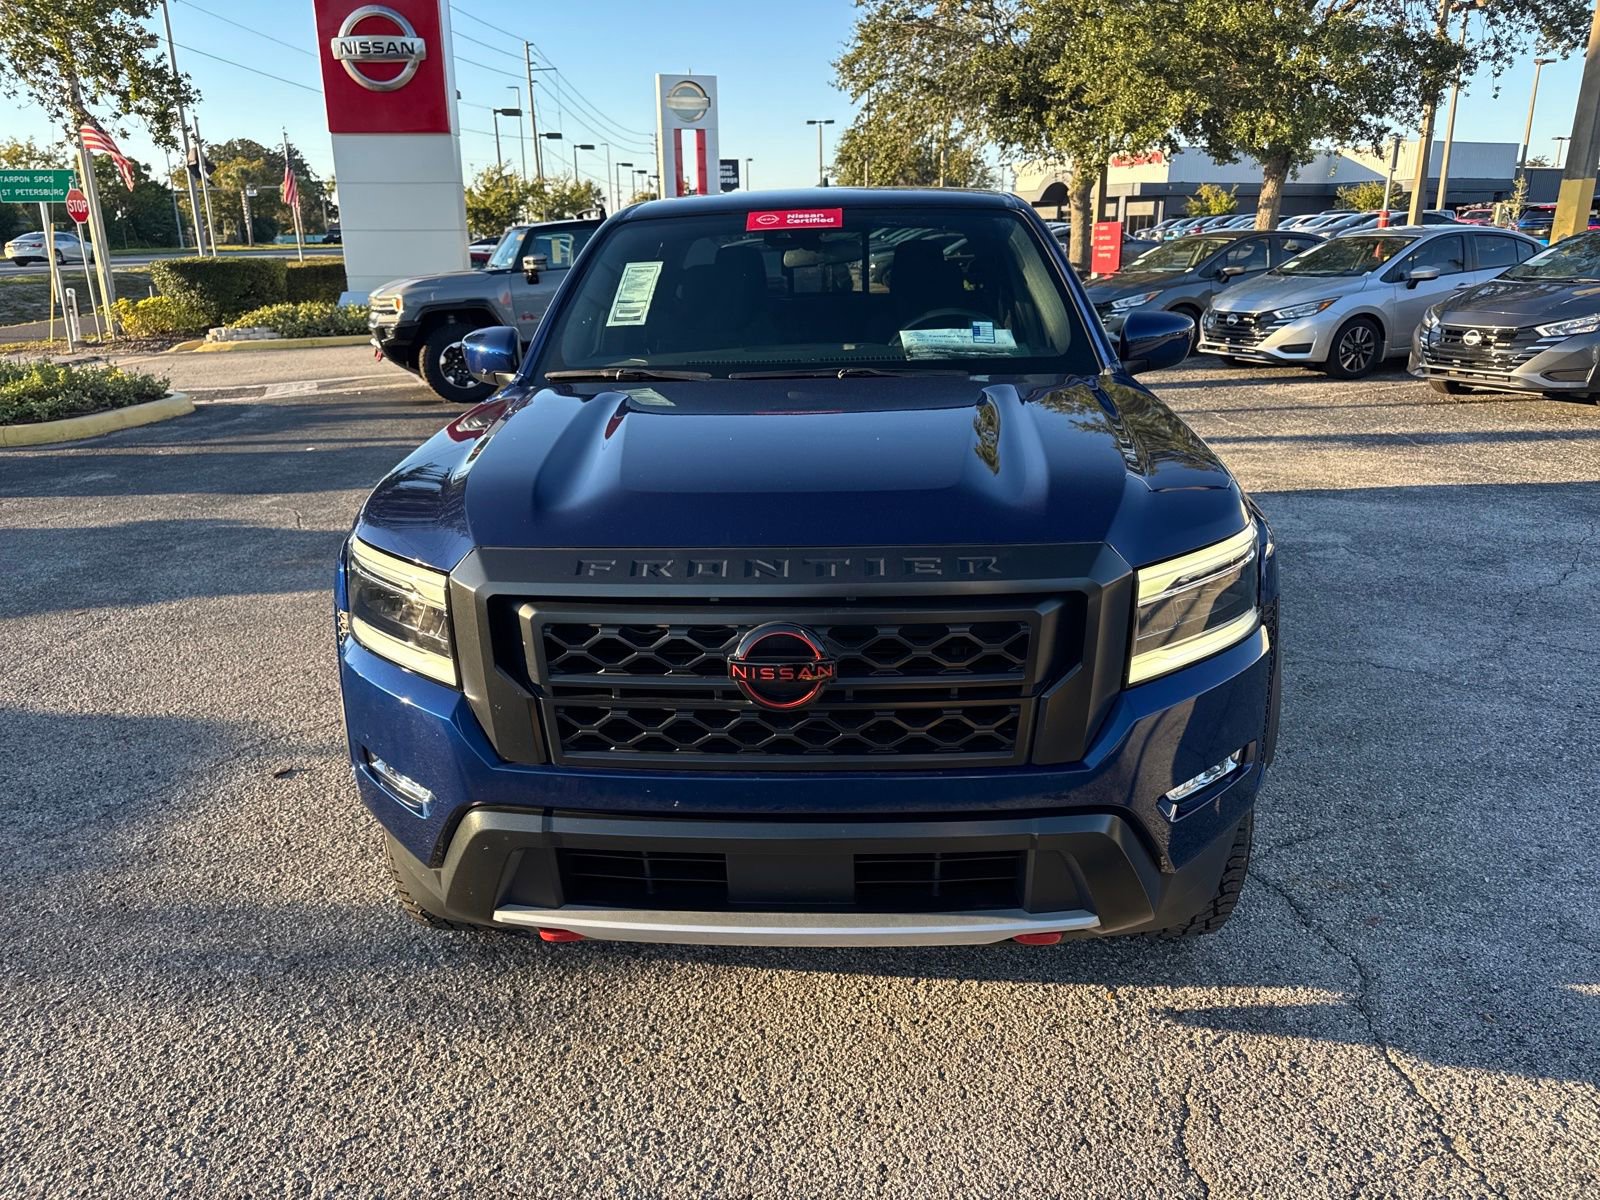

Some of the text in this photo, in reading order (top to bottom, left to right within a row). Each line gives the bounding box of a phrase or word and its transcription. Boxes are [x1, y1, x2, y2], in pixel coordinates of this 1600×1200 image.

[340, 41, 415, 55] NISSAN
[1, 188, 64, 196] ST PETERSBURG
[68, 200, 87, 213] STOP
[575, 556, 1002, 578] FRONTIER
[732, 664, 833, 680] NISSAN
